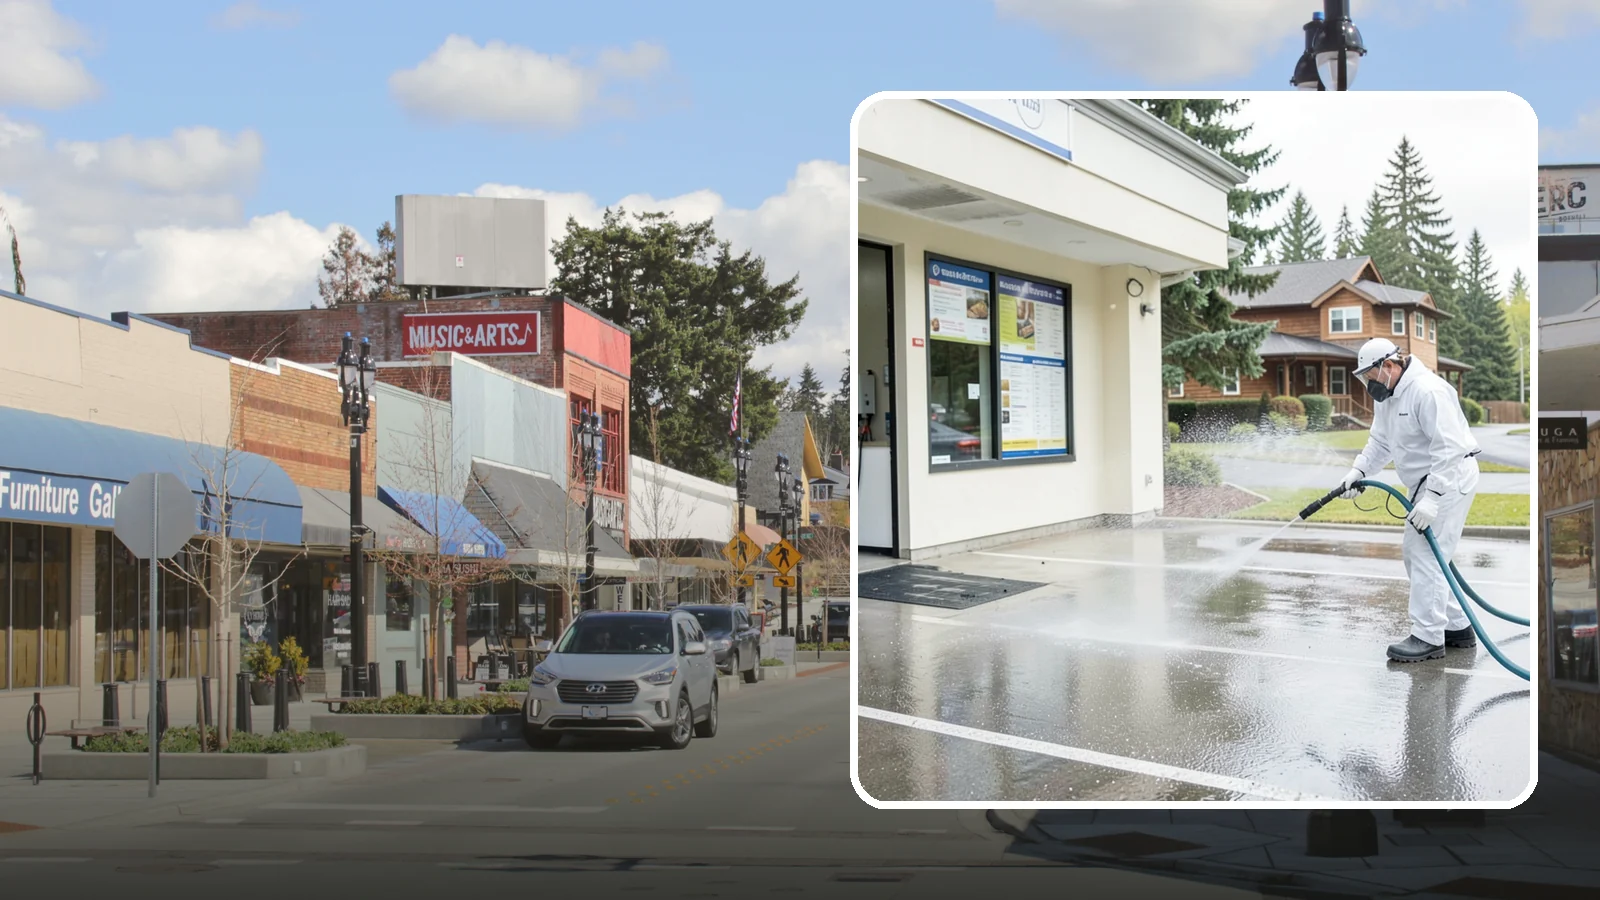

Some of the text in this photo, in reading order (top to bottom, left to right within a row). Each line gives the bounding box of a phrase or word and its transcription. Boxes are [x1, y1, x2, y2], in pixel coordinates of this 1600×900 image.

[409, 323, 519, 348] MUSIC&ARTS
[0, 471, 122, 519] Furniture Gal
[453, 562, 479, 574] SUSHI
